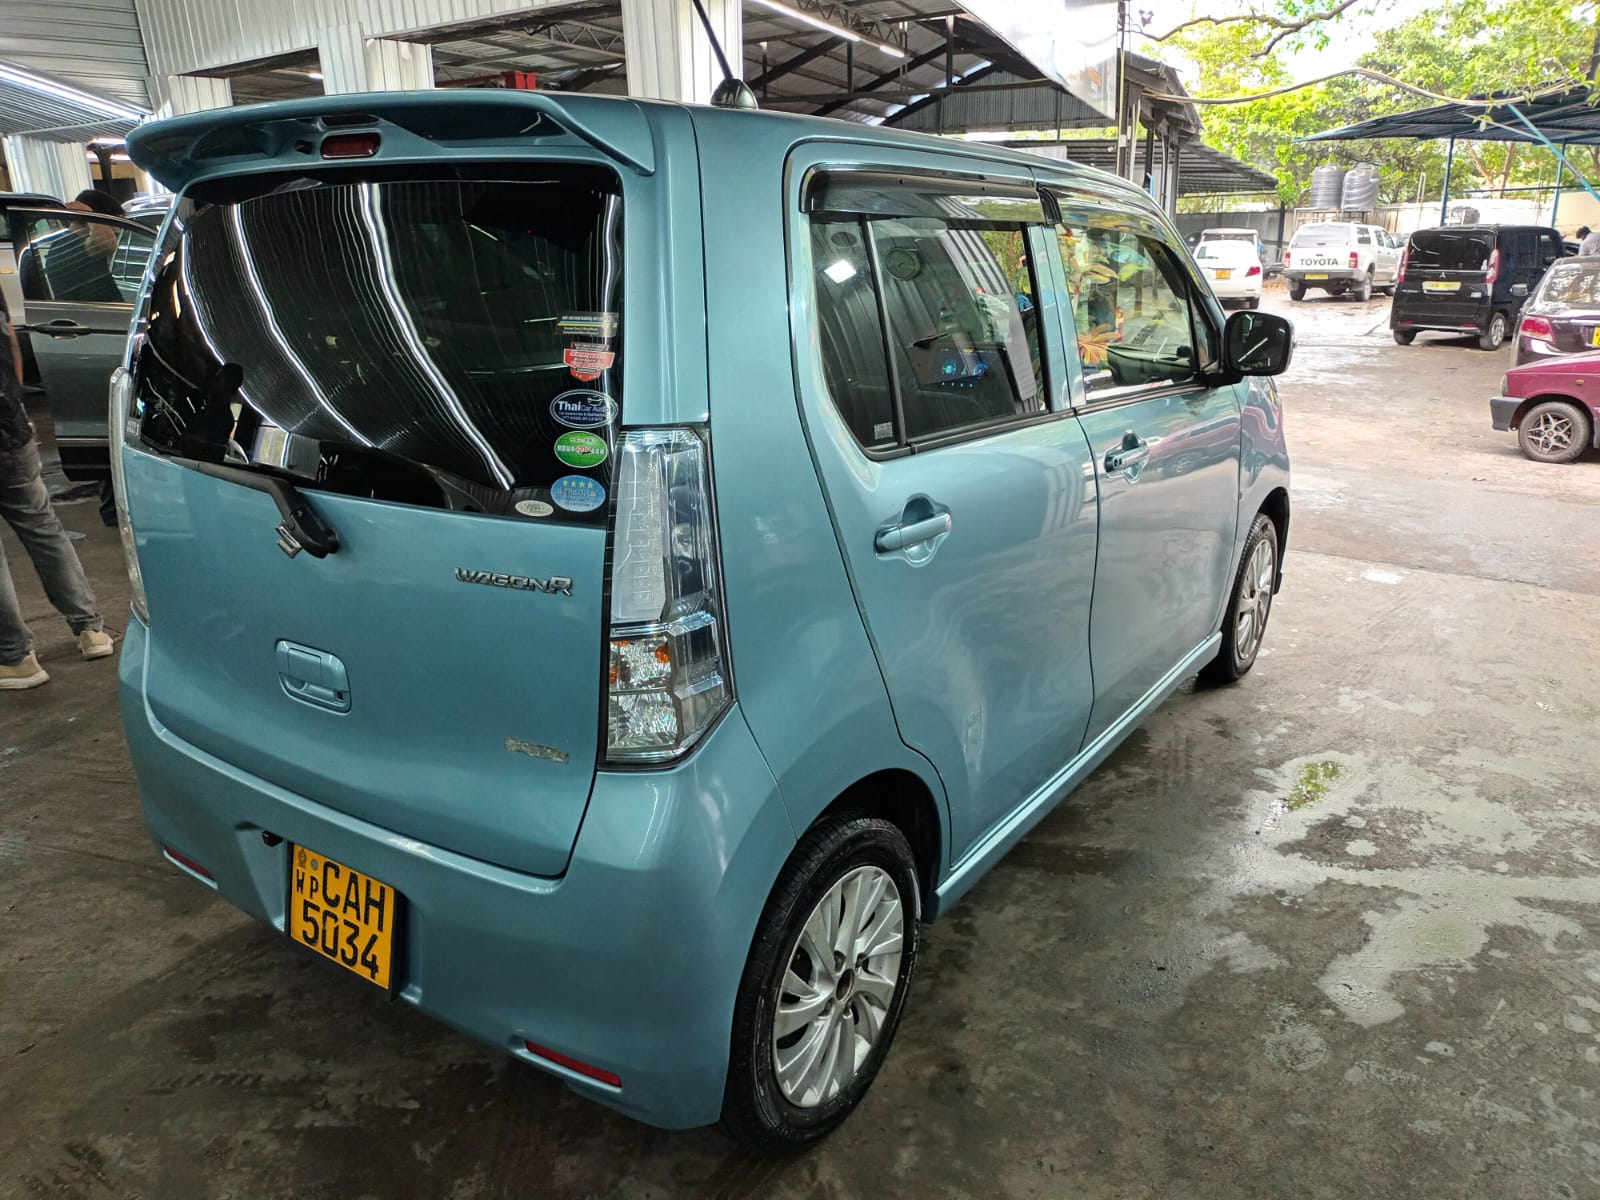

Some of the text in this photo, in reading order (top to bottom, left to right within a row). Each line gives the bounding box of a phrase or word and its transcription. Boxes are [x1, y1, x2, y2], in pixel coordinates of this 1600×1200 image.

[1300, 258, 1339, 266] TOYOTA
[322, 861, 385, 933] CAH
[302, 899, 378, 980] 5034
